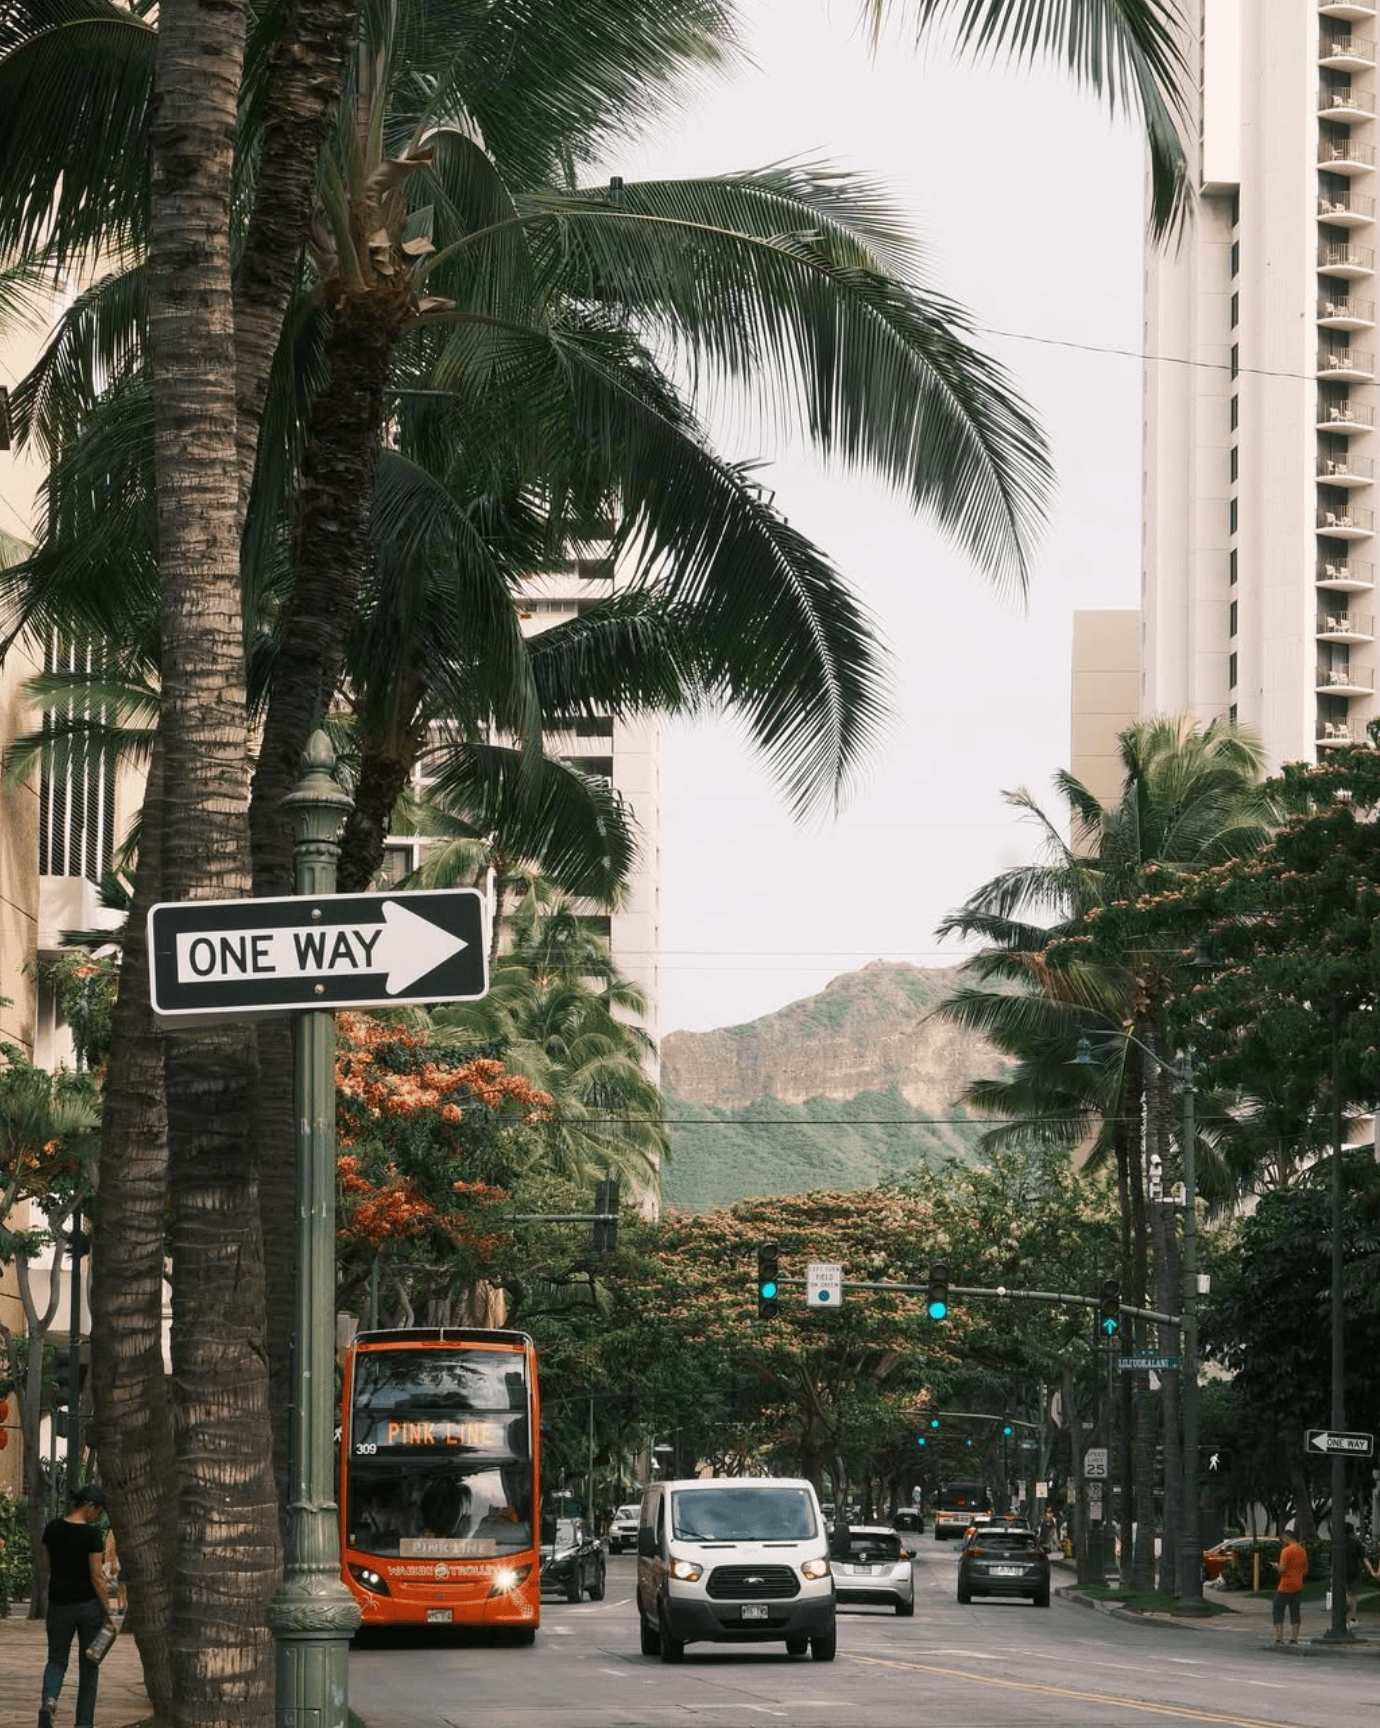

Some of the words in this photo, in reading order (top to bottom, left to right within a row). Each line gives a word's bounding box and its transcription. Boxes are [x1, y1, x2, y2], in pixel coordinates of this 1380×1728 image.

[189, 934, 277, 977] ONE
[292, 929, 383, 971] WAY
[388, 1421, 435, 1445] PINK
[445, 1421, 491, 1446] LINE
[355, 1443, 377, 1455] 309
[1326, 1437, 1345, 1448] ONE
[1347, 1439, 1366, 1449] WAY
[1086, 1464, 1106, 1475] 25
[412, 1542, 448, 1553] PINK
[452, 1541, 486, 1553] LINE
